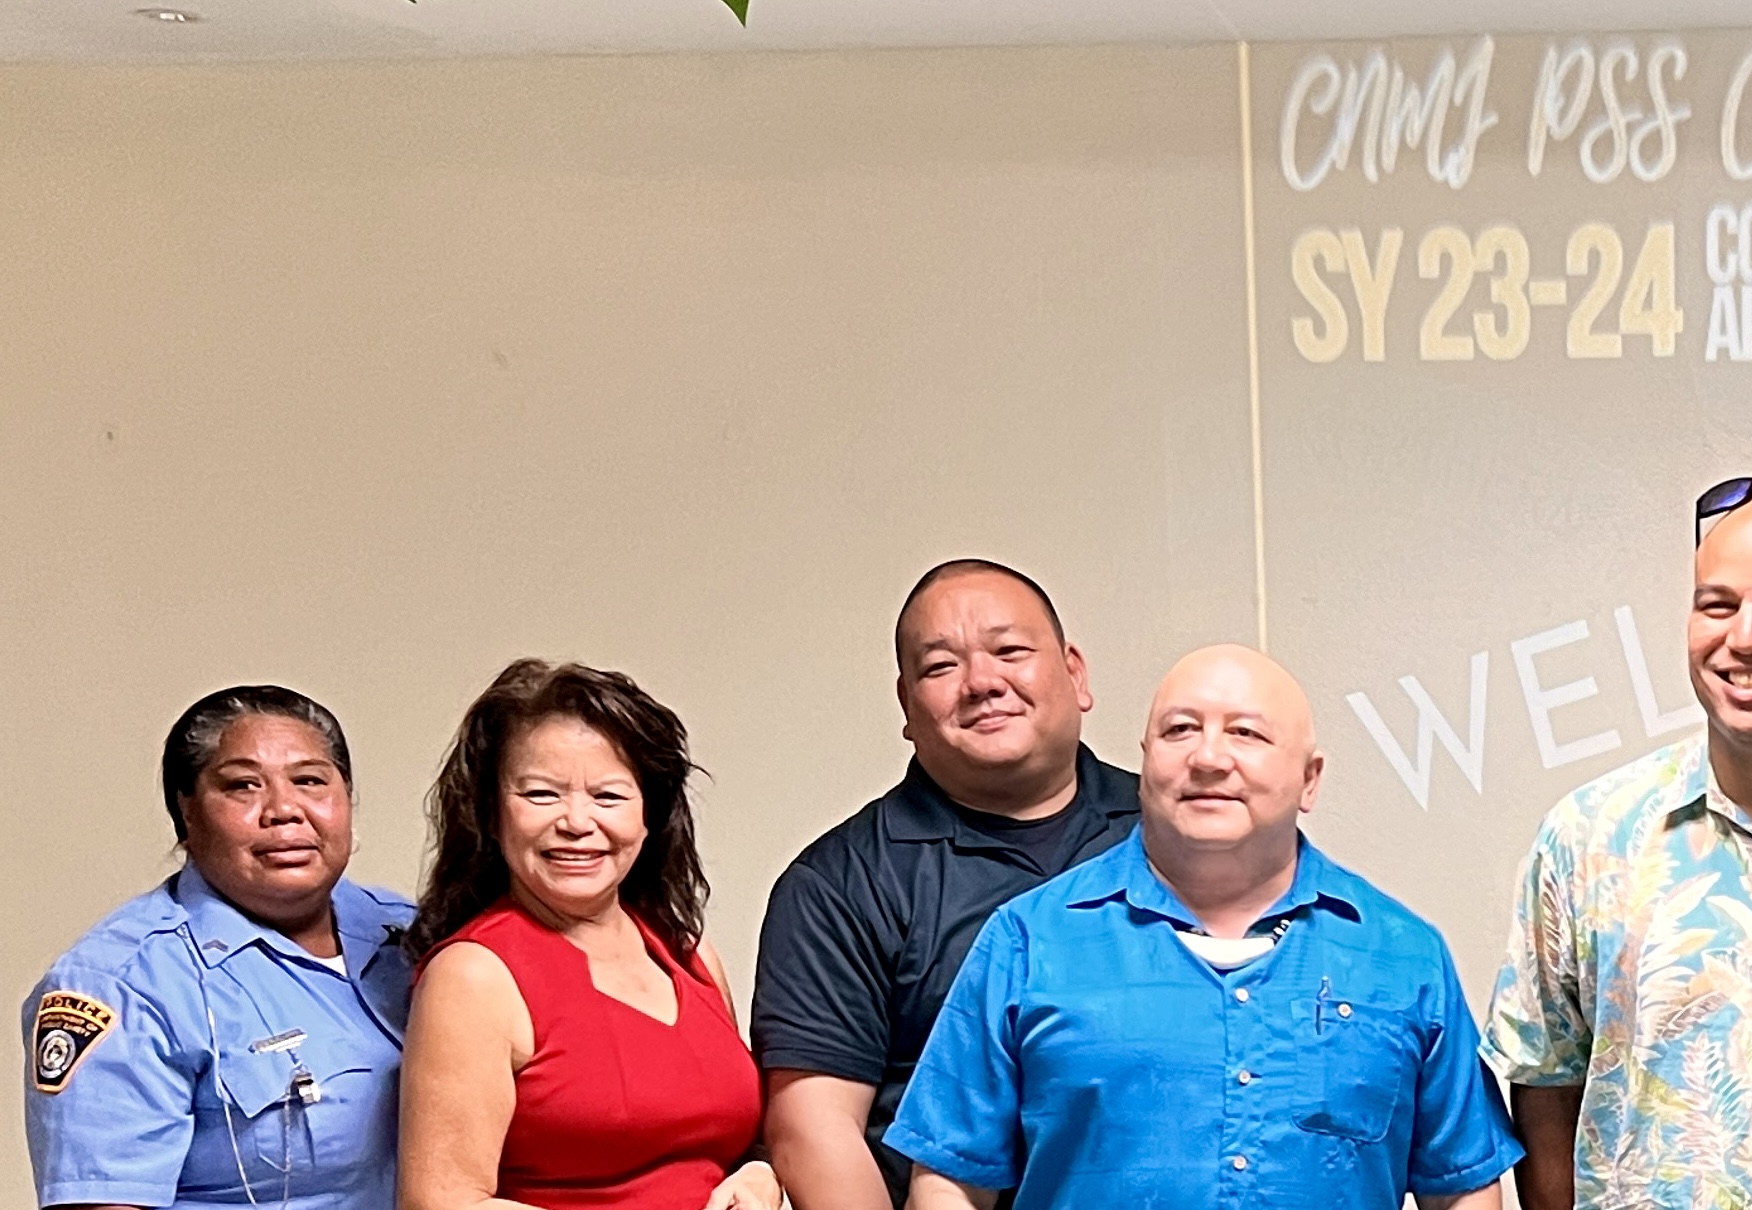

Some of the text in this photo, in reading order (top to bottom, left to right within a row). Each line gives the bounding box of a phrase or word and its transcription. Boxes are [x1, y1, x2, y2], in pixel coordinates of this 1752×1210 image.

[1527, 34, 1692, 181] PSS
[1291, 222, 1684, 363] SY 23-24
